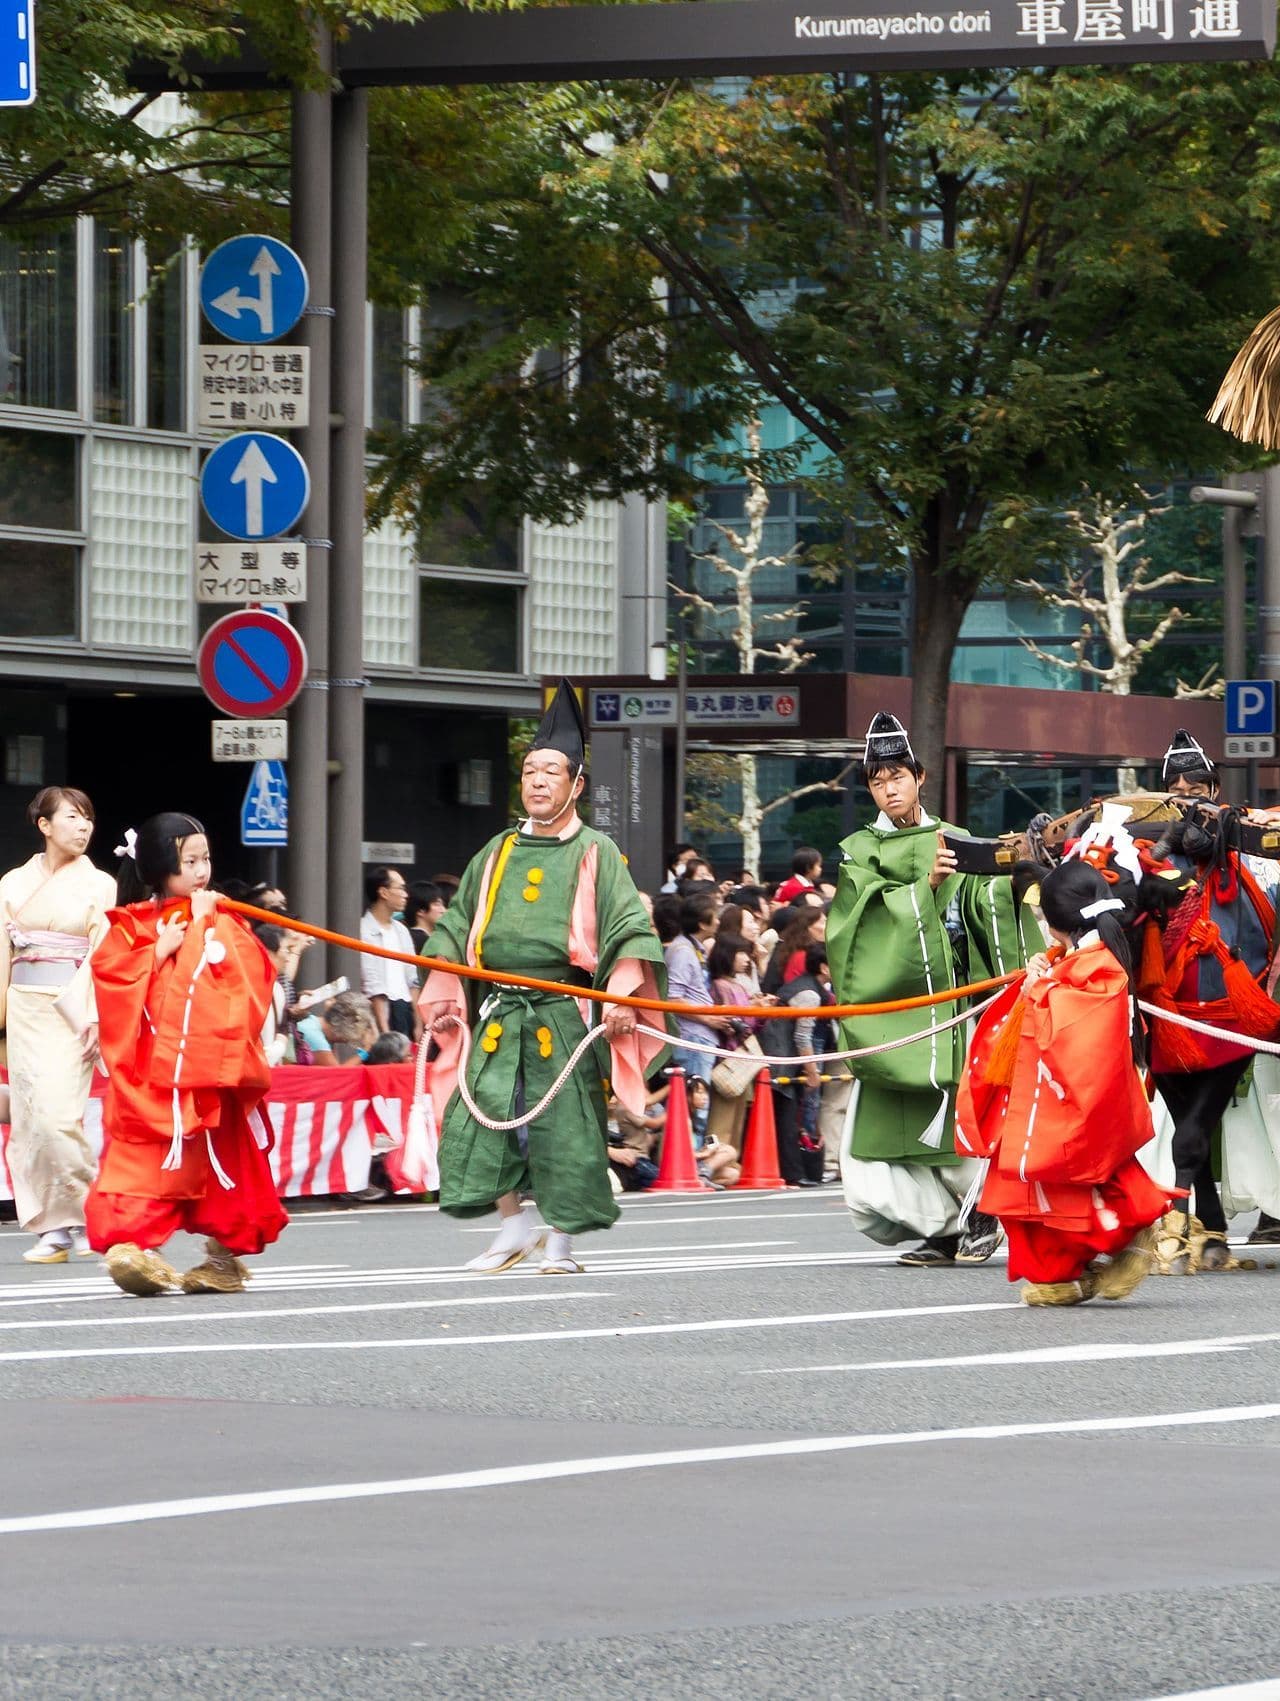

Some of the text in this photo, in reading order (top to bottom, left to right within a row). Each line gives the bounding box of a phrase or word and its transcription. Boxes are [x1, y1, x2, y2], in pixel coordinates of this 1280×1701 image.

[794, 11, 991, 40] Kurumayacho dori
[1015, 0, 1242, 45] 車屋町通
[1237, 686, 1266, 729] P
